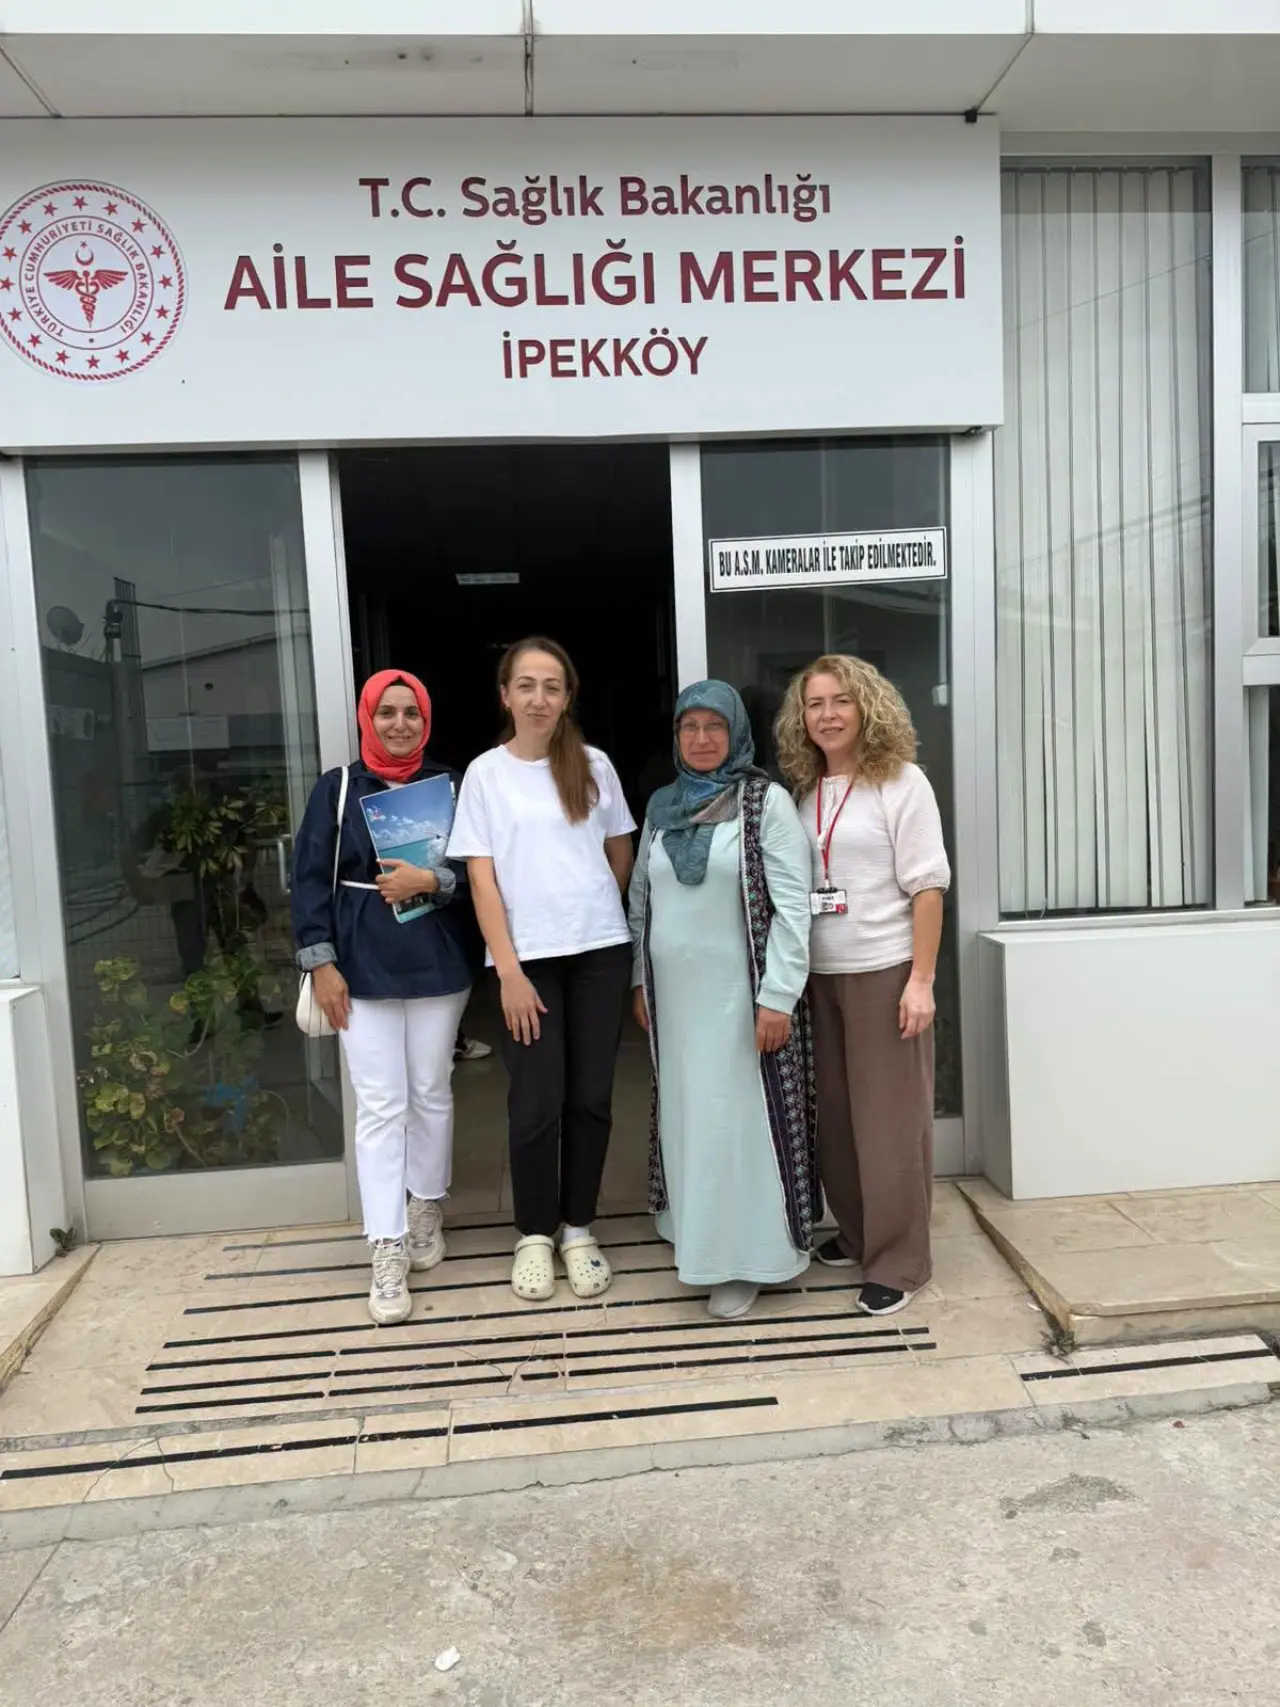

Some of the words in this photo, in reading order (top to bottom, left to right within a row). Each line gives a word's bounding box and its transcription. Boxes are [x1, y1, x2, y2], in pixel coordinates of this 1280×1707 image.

[359, 177, 446, 218] T.C.
[462, 175, 604, 225] Sağlık
[620, 173, 831, 223] Bakanlığı
[25, 220, 92, 281] CUMHURİYETİ
[97, 224, 139, 260] SAĞLIK
[119, 262, 149, 334] BAKANLIĞI
[224, 242, 374, 310] AİLE
[395, 239, 655, 308] SAĞLIĞI
[680, 235, 966, 303] MERKEZİ
[26, 286, 64, 337] TÜRKİYE
[502, 328, 709, 379] İPEKKÖY
[719, 551, 732, 577] BU
[735, 549, 763, 576] A.S.M.
[765, 547, 820, 574] KAMERALAR
[823, 540, 837, 572] İLE
[839, 538, 865, 570] TAKİP
[867, 536, 937, 569] EDİLMEKTEDİR.
